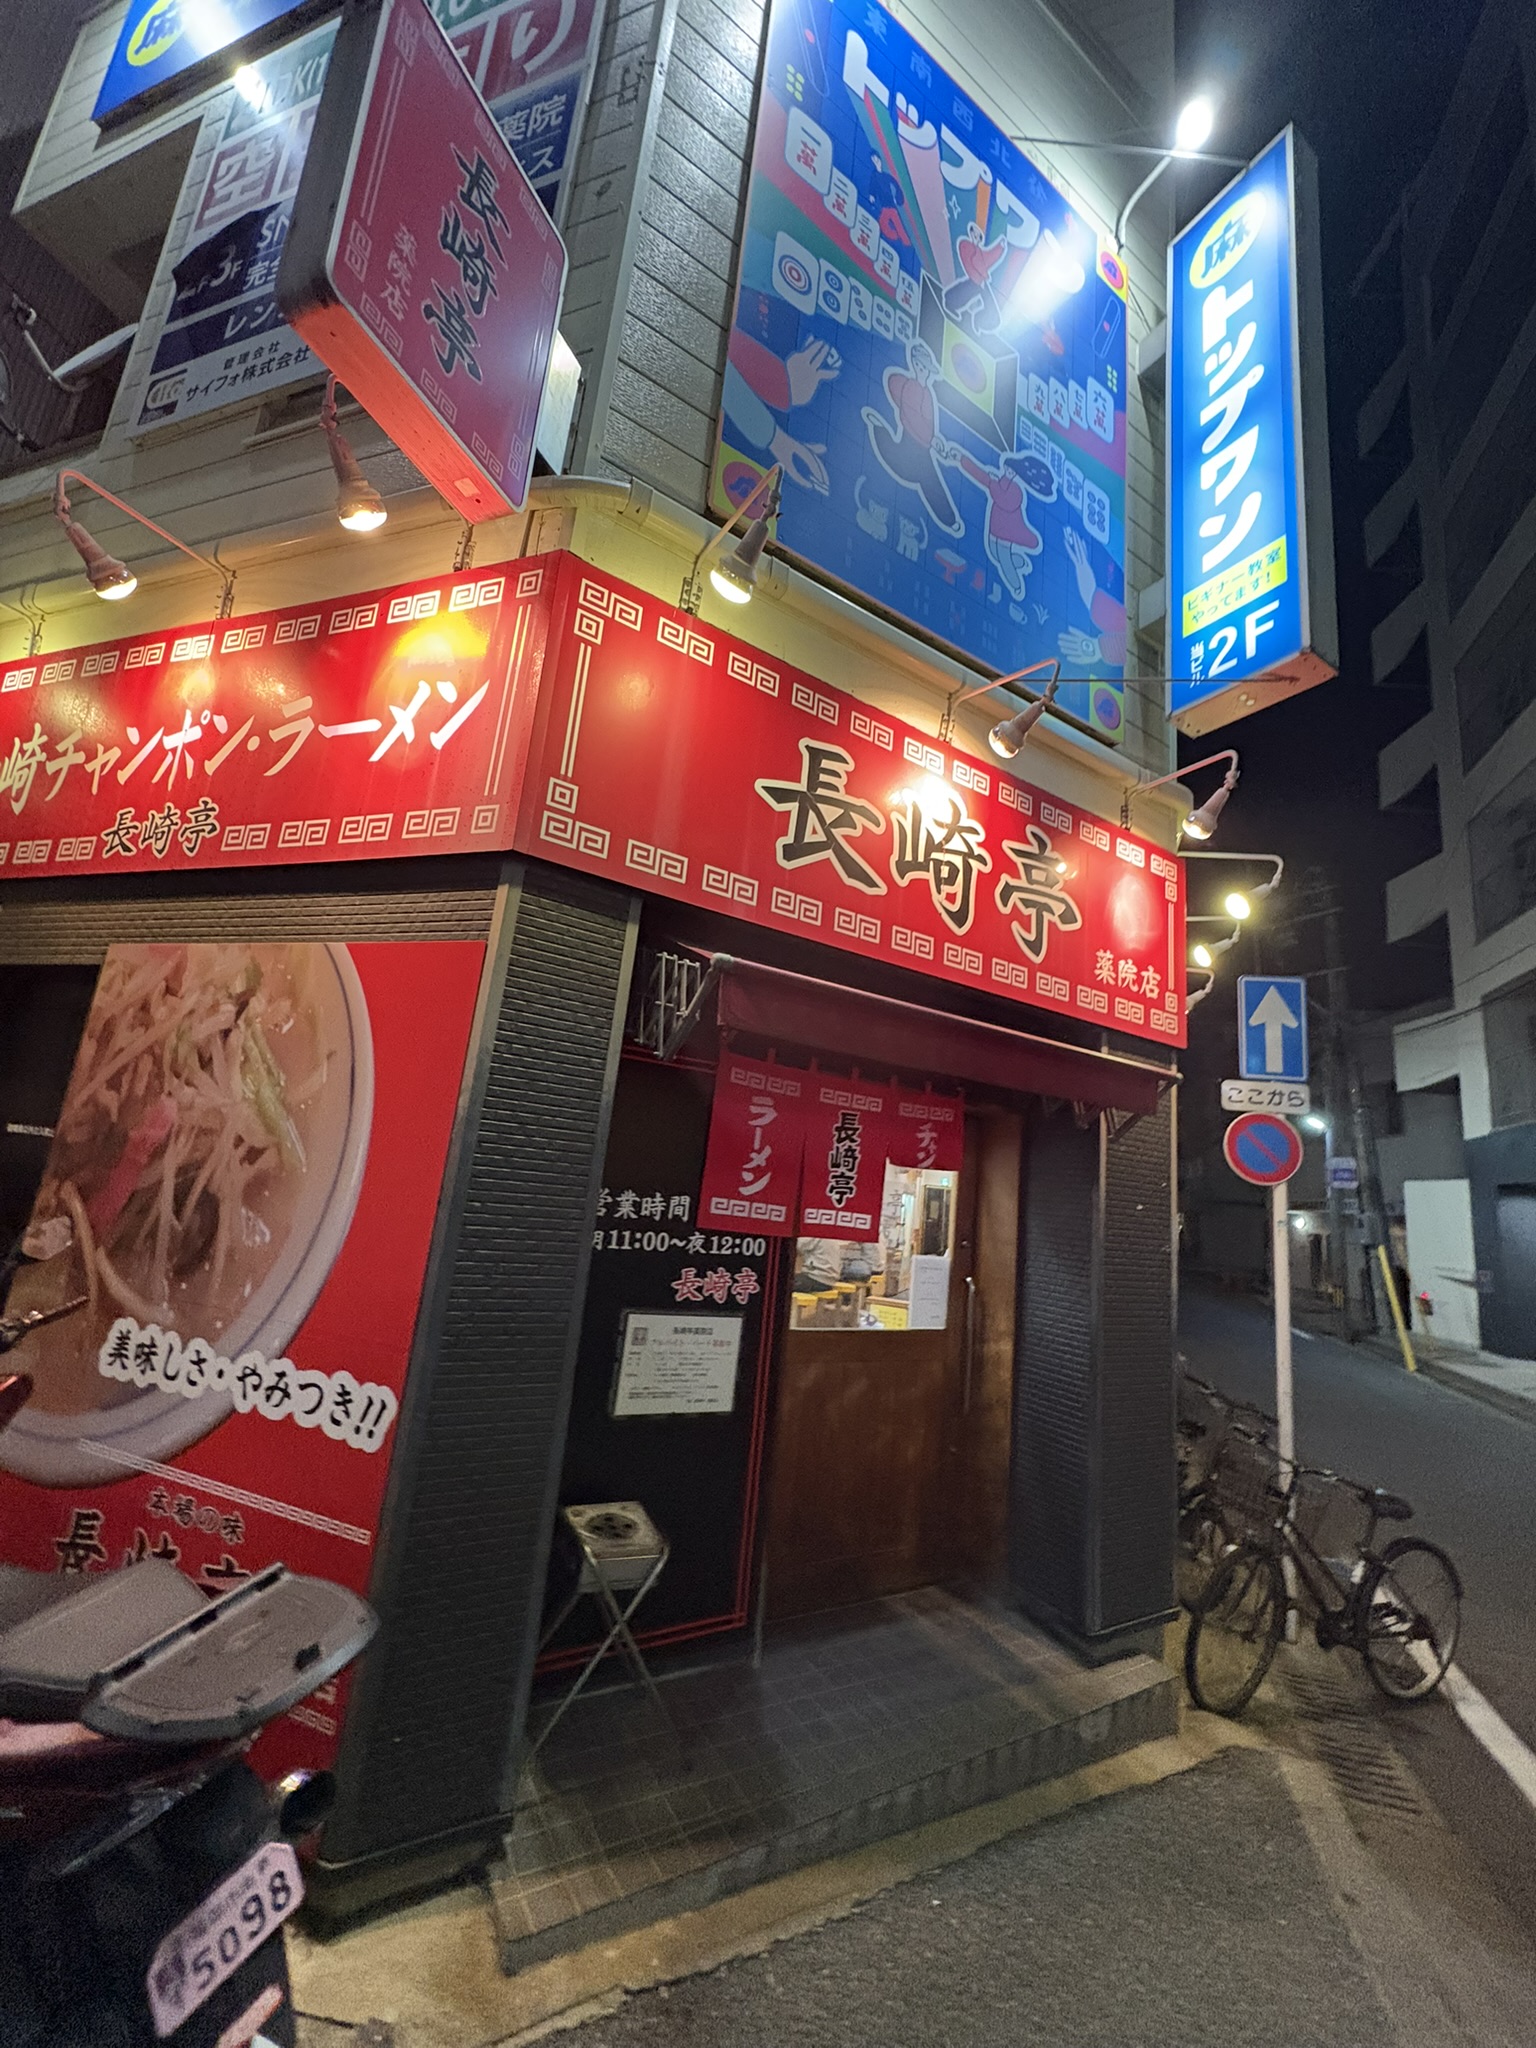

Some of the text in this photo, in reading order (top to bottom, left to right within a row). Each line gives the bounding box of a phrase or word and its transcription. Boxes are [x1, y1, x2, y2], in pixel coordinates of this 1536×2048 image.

[186, 345, 310, 402] サイフォ株式会社
[1199, 279, 1265, 574] トップワン
[1188, 546, 1281, 612] ビギナー教室
[1208, 599, 1280, 679] 2F
[101, 797, 220, 859] 長崎亭
[755, 737, 1083, 964] 長崎亭
[1094, 949, 1161, 999] 薬院店
[1228, 1087, 1304, 1107] ここから
[738, 1096, 778, 1196] ラーメン
[671, 1267, 760, 1305] 長崎亭
